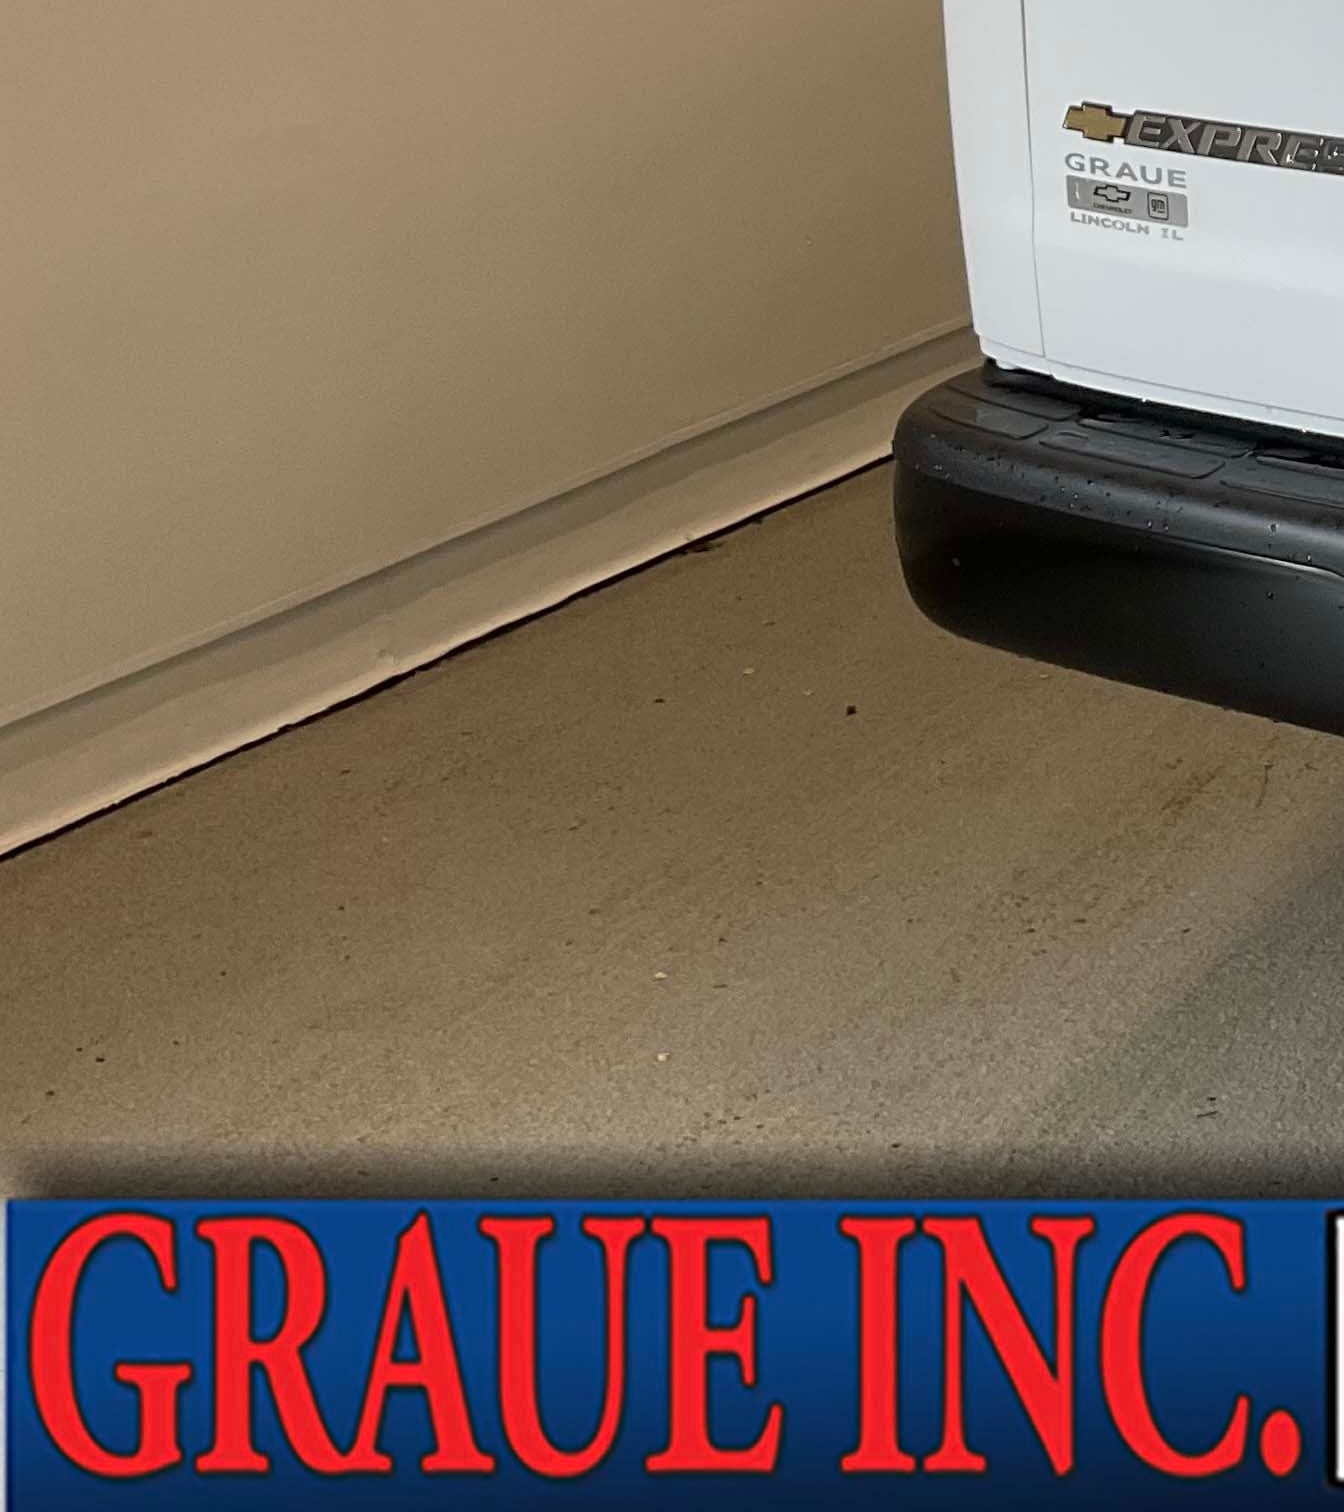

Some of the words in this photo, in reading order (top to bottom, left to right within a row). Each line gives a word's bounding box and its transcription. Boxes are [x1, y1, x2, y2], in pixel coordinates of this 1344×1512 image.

[1065, 152, 1187, 188] GRAUE
[1070, 210, 1150, 235] LINCOLN
[1161, 227, 1184, 241] IL
